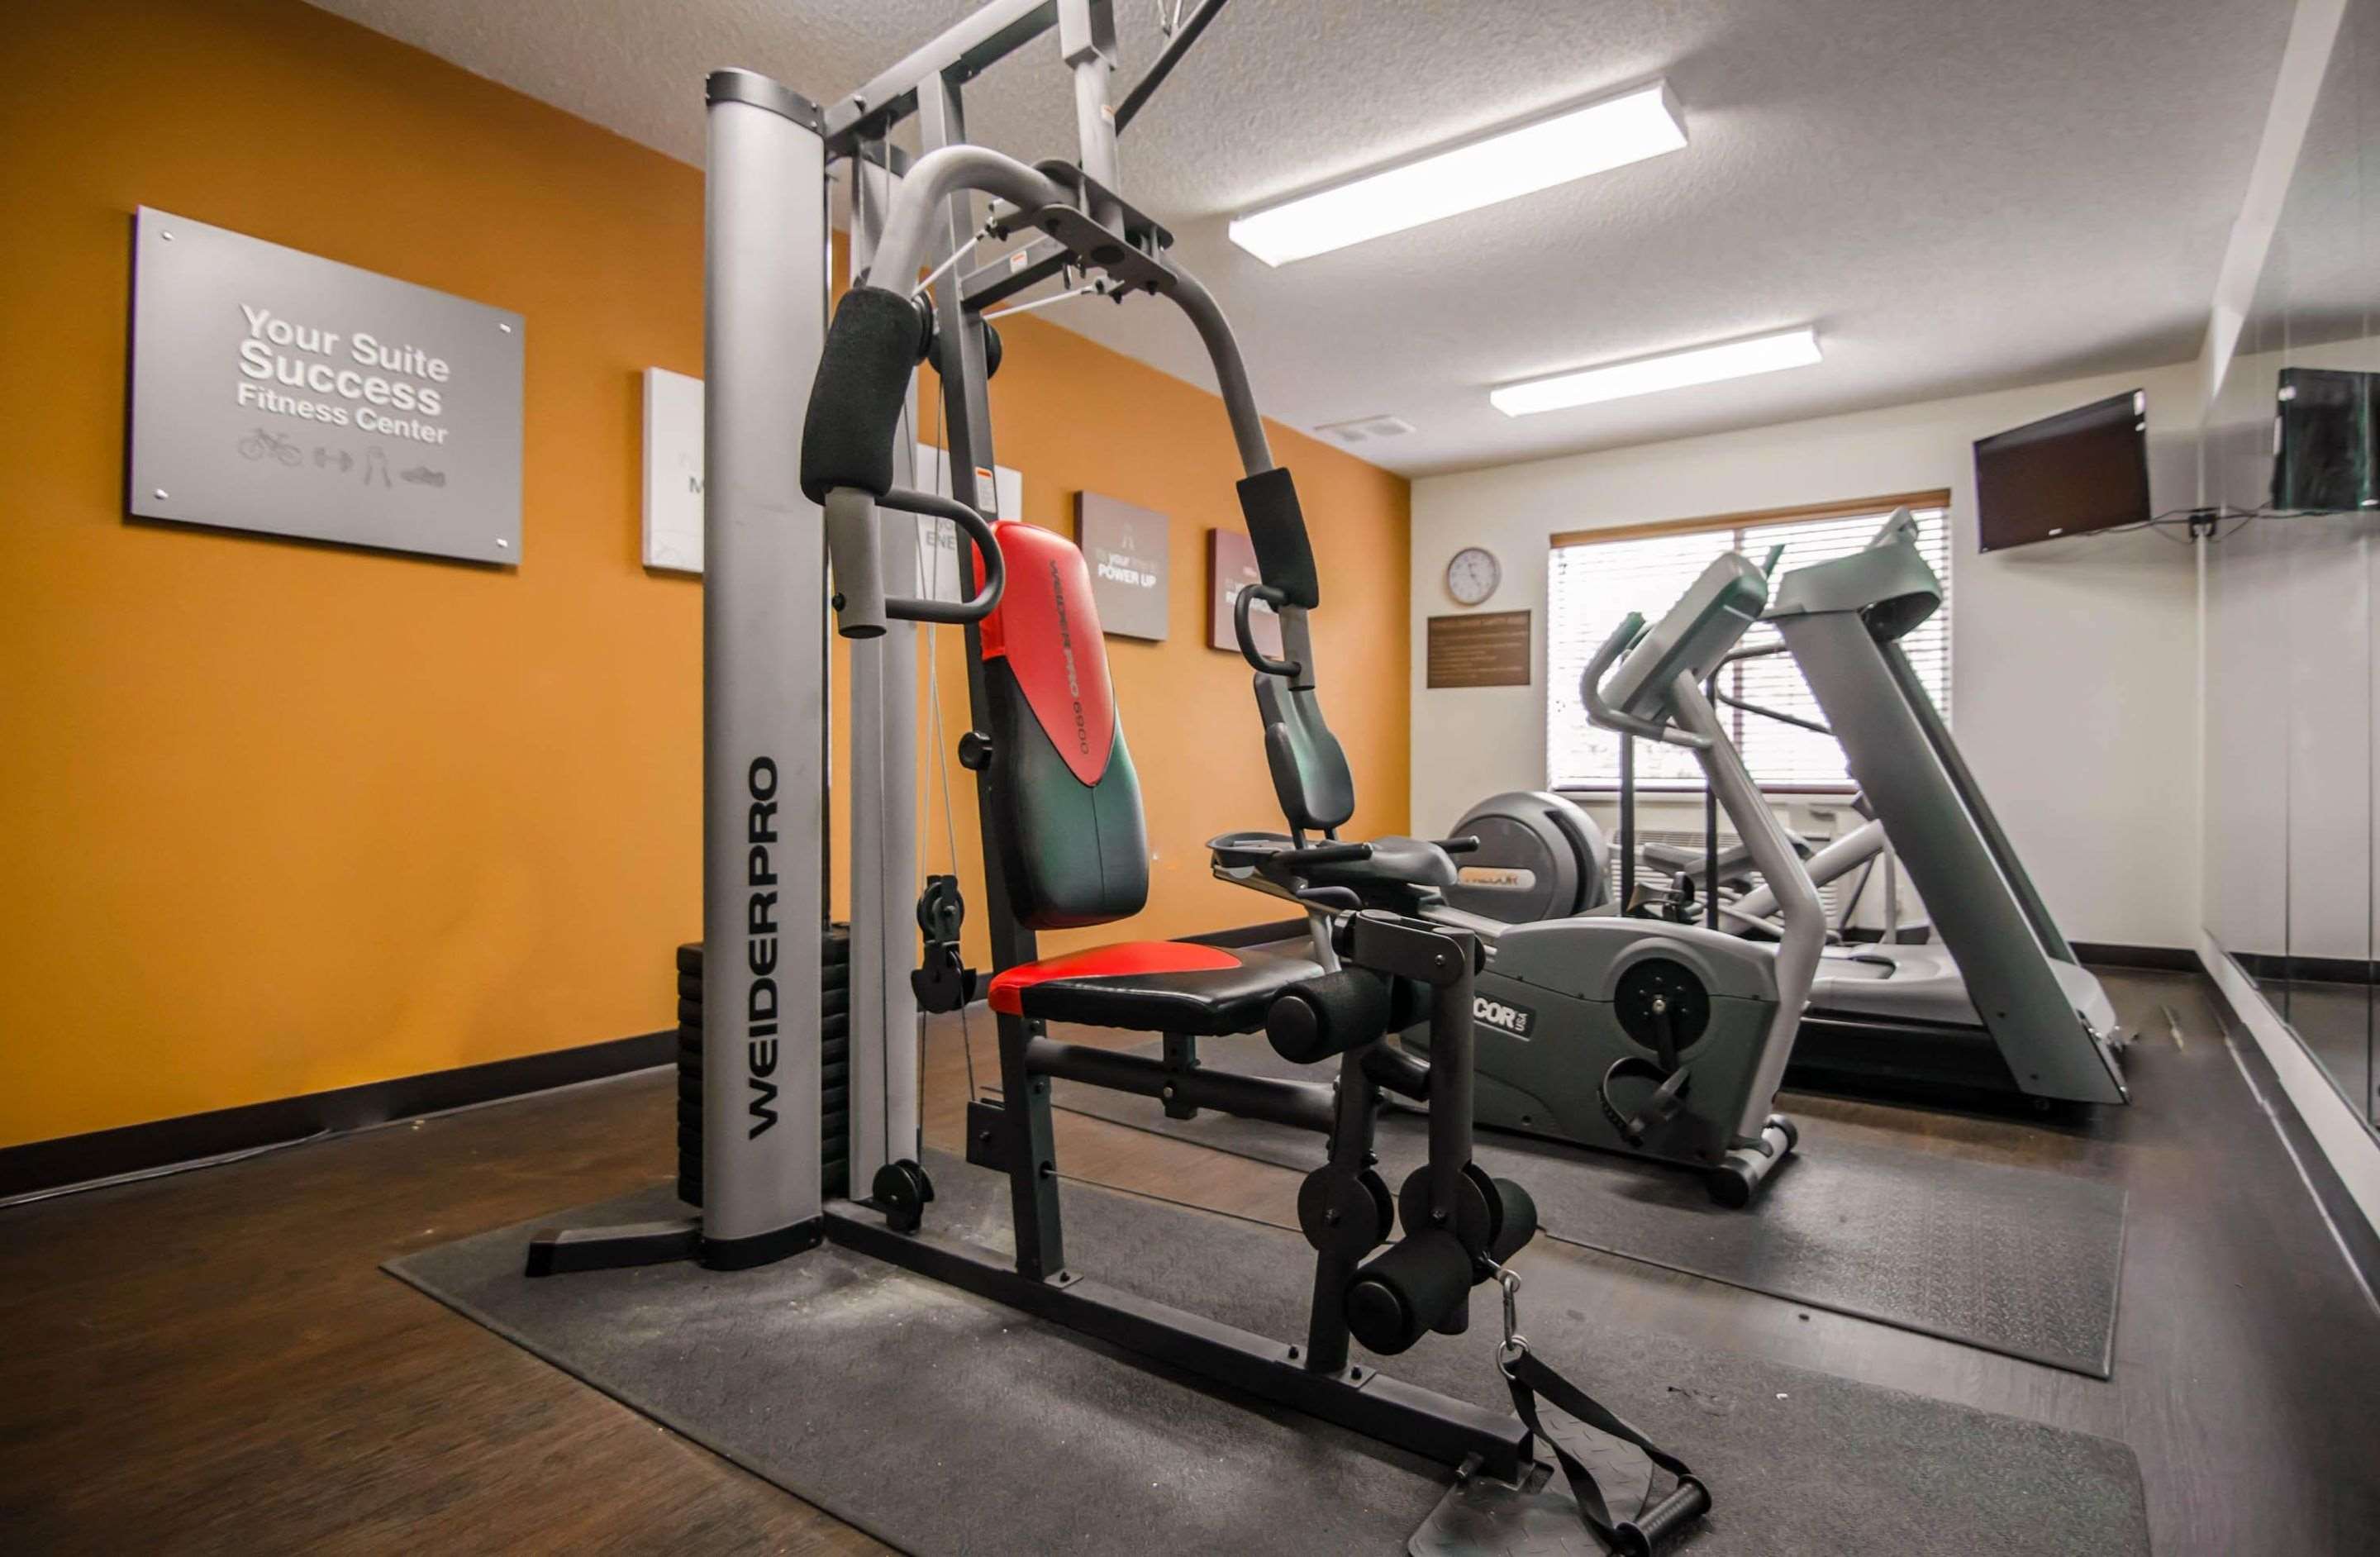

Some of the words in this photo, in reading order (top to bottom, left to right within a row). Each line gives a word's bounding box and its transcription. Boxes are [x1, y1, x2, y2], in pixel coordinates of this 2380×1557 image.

[240, 303, 340, 355] Your
[350, 333, 450, 383] Suite
[240, 339, 443, 416] Success
[238, 382, 349, 426] Fitness
[355, 407, 449, 445] Center
[1097, 564, 1139, 584] POWER
[1140, 574, 1157, 588] UP
[748, 755, 778, 1140] WEIDERPRO
[1473, 997, 1516, 1029] COR
